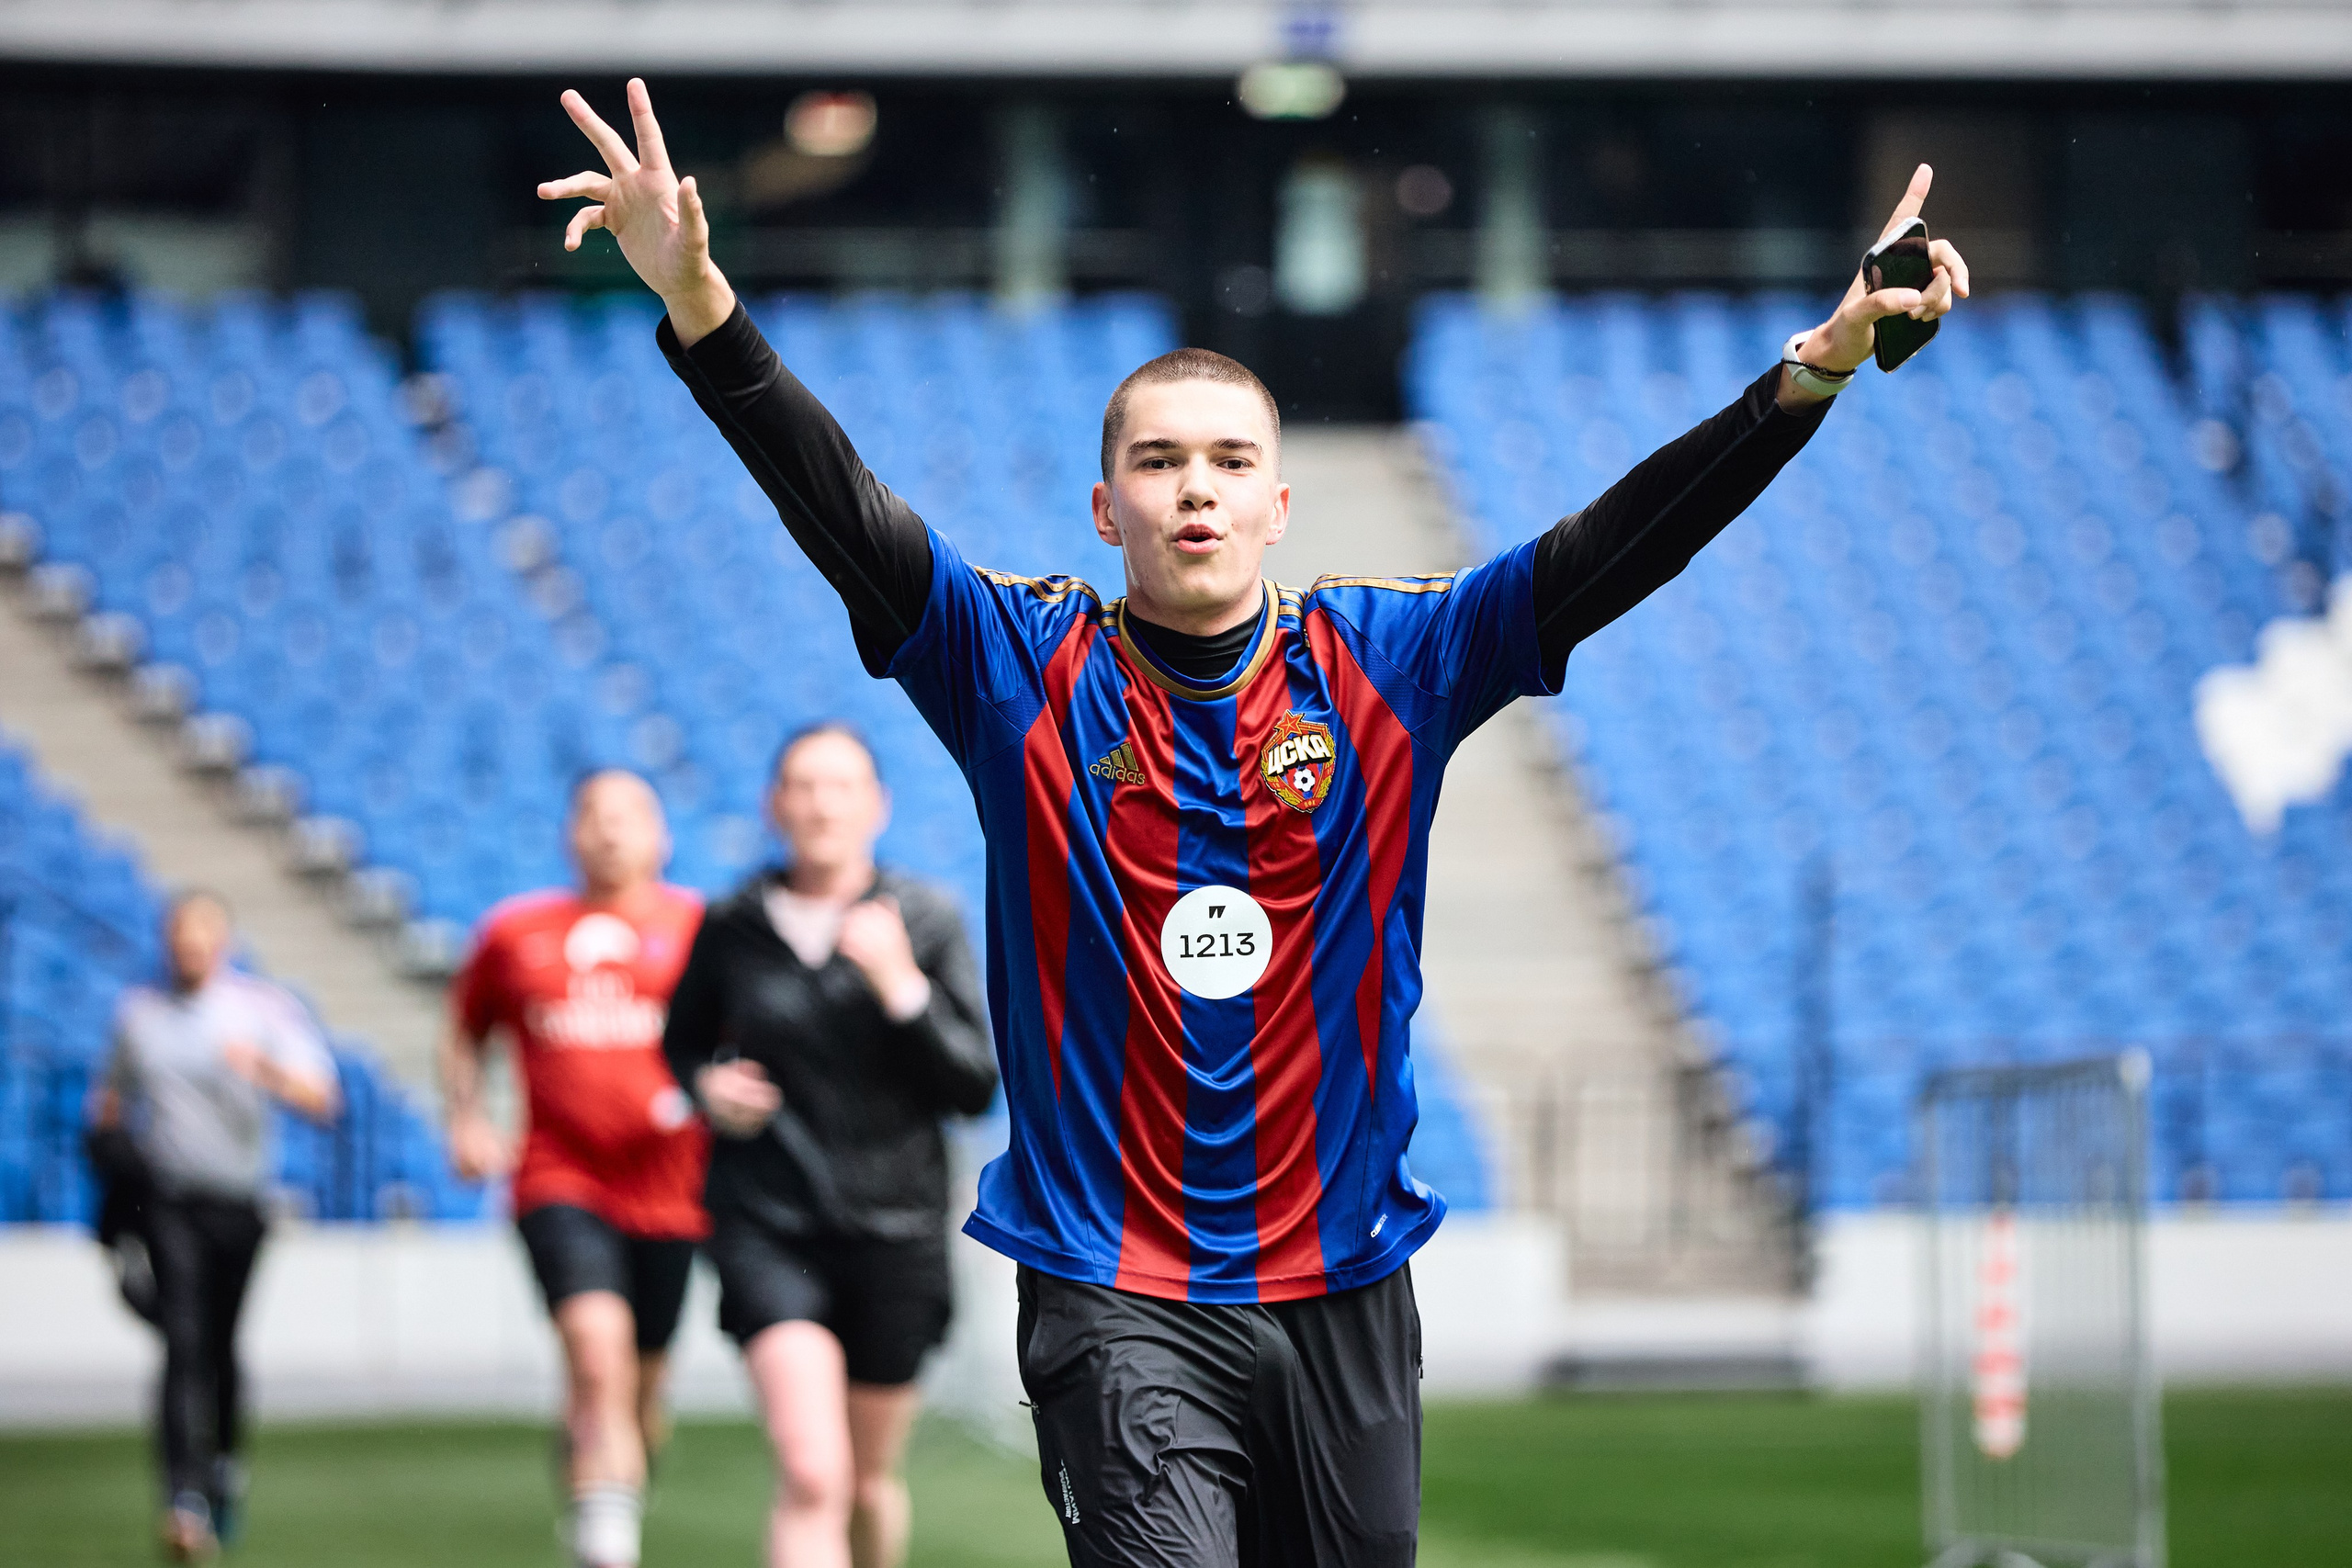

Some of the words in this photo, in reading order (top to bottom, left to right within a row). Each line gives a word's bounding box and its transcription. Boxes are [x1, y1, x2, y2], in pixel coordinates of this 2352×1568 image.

[1267, 734, 1332, 776] ЦСКА
[1089, 763, 1146, 785] adidas
[1180, 932, 1255, 958] 1213
